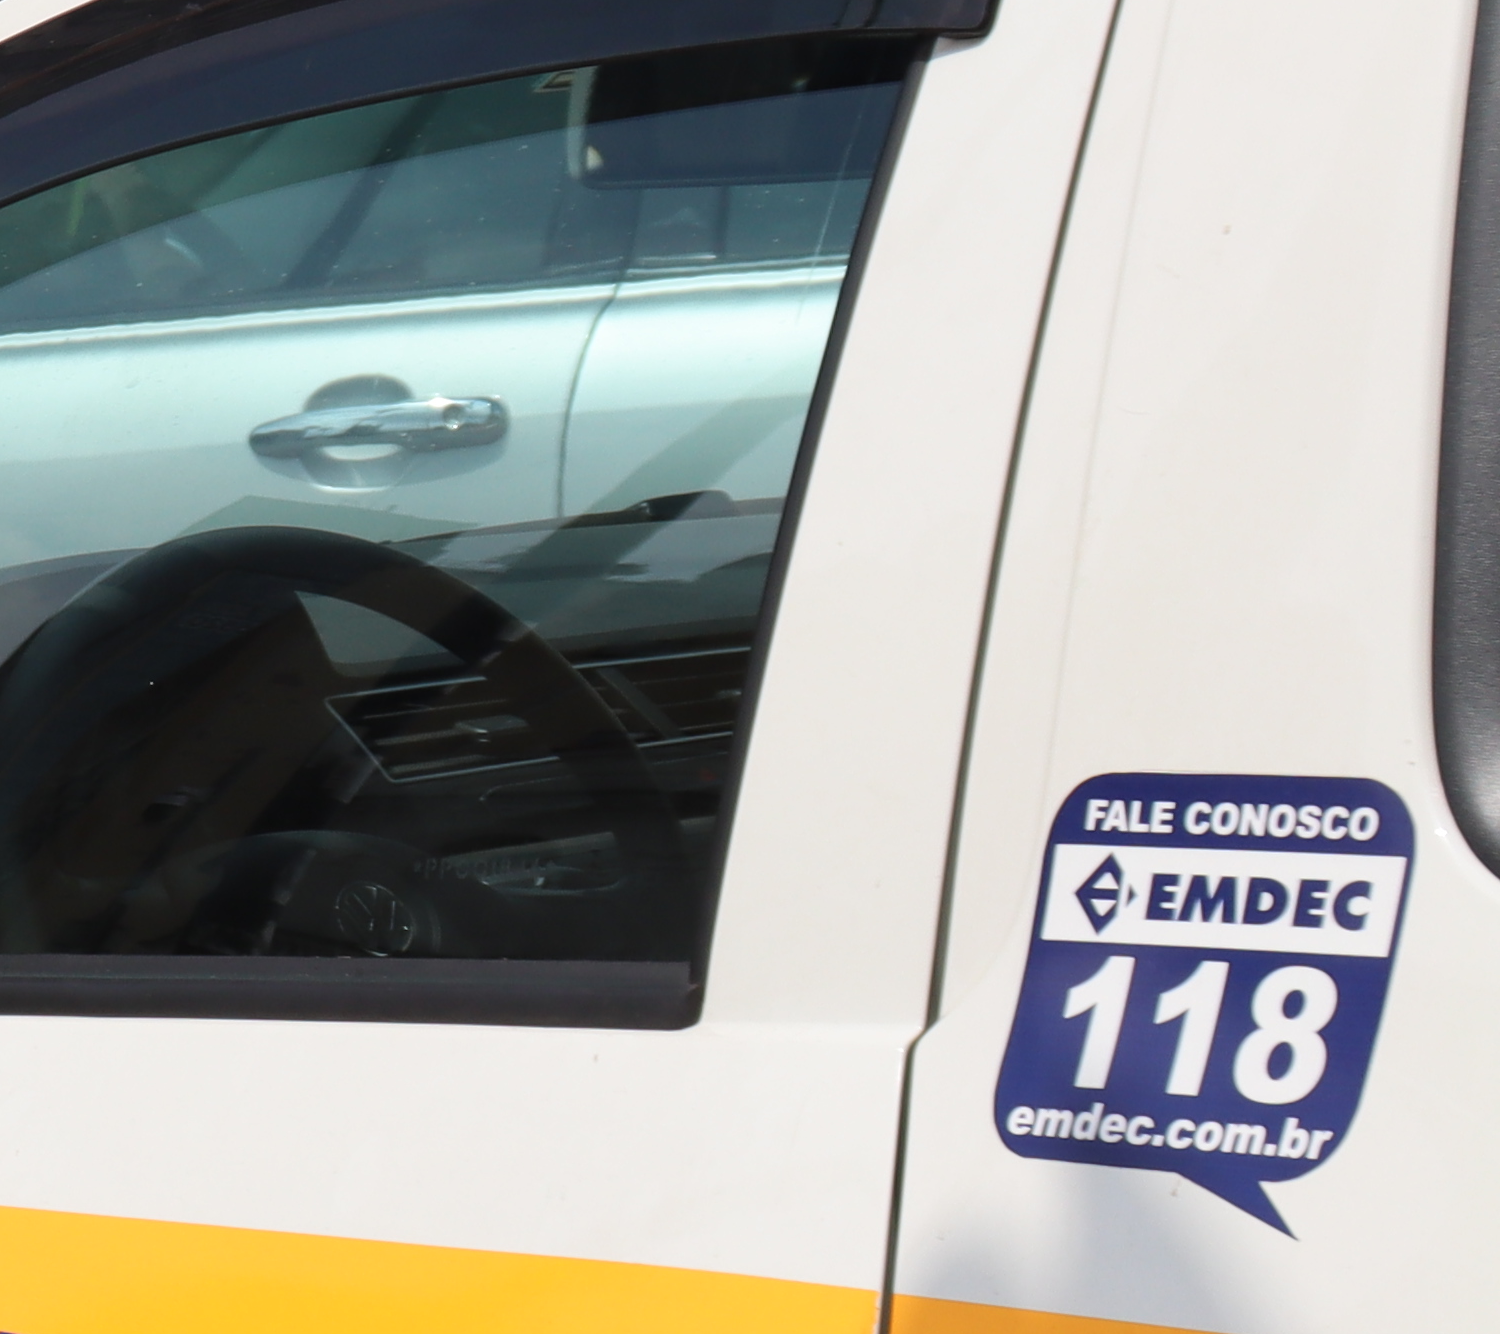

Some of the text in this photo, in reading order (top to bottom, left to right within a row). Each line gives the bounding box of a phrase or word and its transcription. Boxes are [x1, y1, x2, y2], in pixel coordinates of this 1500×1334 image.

[1083, 799, 1380, 842] FALE CONOSCO
[1145, 873, 1374, 931] EMDEC
[1063, 955, 1339, 1105] 118
[1006, 1103, 1333, 1160] emdec.com.br
